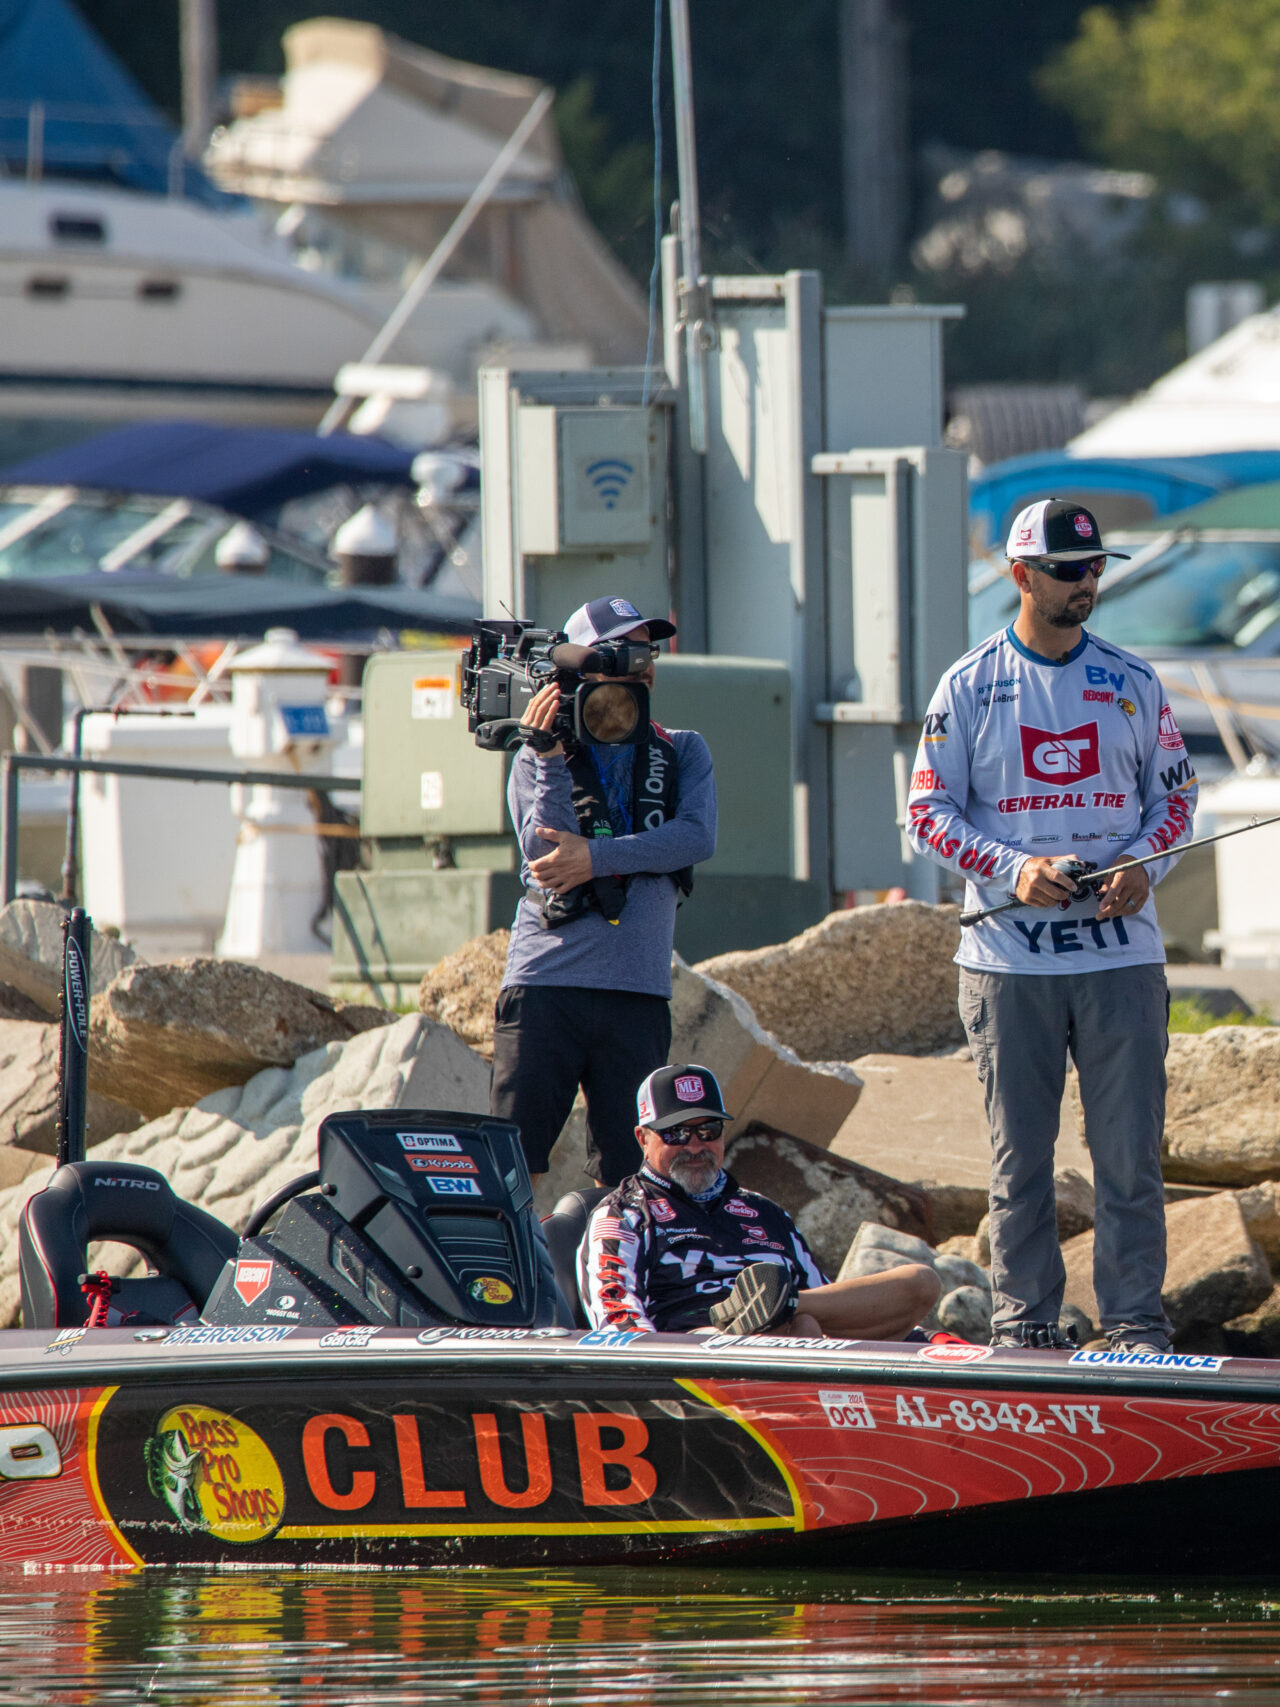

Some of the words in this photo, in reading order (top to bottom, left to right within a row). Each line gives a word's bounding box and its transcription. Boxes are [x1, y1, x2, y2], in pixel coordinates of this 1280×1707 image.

[645, 744, 669, 794] Onyx
[998, 793, 1086, 814] GENERAL
[958, 848, 999, 878] OIL
[1014, 916, 1130, 954] YETI
[68, 950, 87, 1037] POWER-POLE
[679, 1081, 702, 1093] MLF
[416, 1137, 456, 1148] OPTIMA
[428, 1159, 474, 1169] Kubota
[286, 1311, 300, 1319] OAK
[186, 1327, 295, 1344] FERGUSON
[320, 1333, 370, 1347] Garcia
[455, 1327, 530, 1340] Kubota
[736, 1336, 862, 1350] MERCURY
[1072, 1351, 1220, 1368] LOWRANCE
[829, 1406, 868, 1426] OCT
[896, 1394, 1106, 1434] AL-8342-VY
[177, 1412, 239, 1448] Bass
[200, 1447, 241, 1484] Pro
[302, 1412, 658, 1511] CLUB
[212, 1482, 280, 1528] Shops
